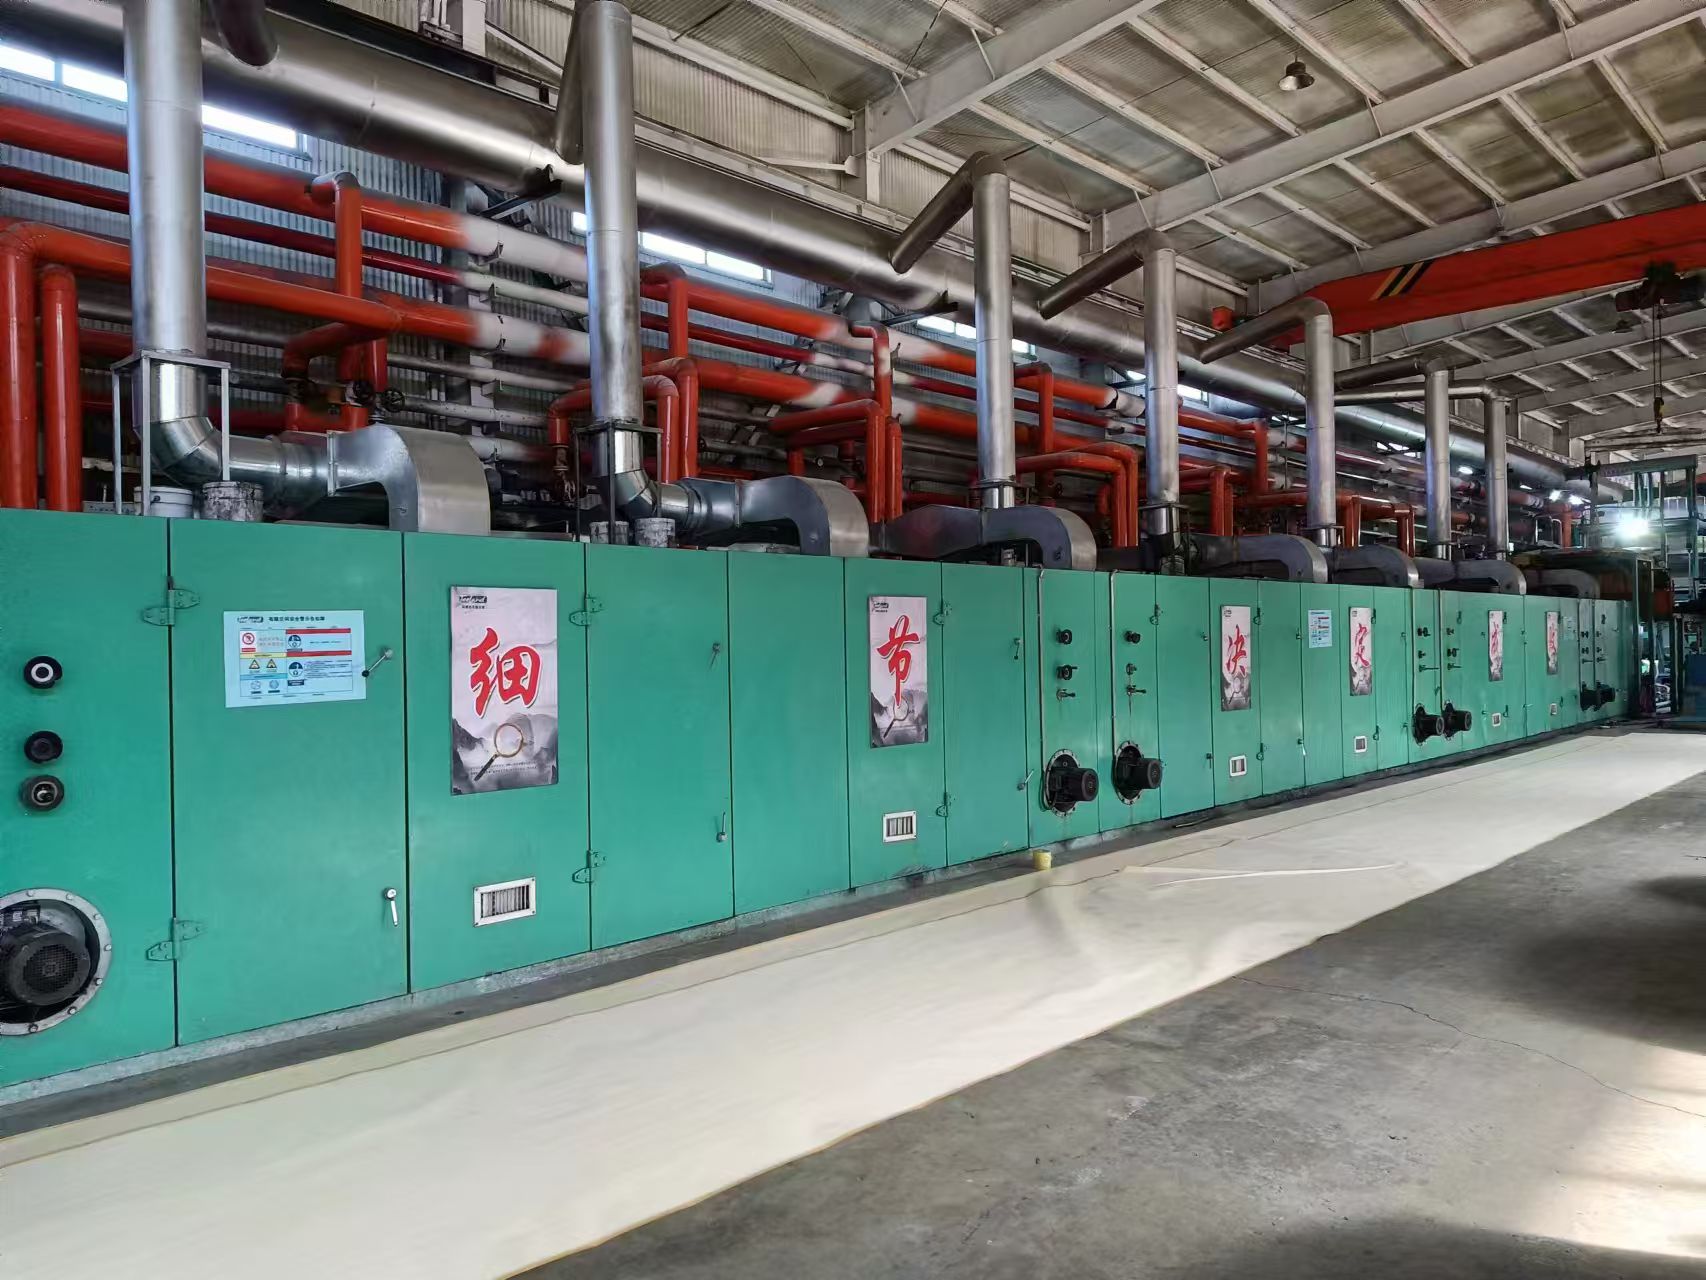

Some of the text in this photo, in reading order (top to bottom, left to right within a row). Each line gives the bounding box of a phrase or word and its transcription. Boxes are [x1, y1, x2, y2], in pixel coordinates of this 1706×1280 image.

[469, 627, 541, 718] 细
[876, 615, 920, 707] 节
[1226, 624, 1247, 676] 决
[1354, 623, 1370, 667] 定
